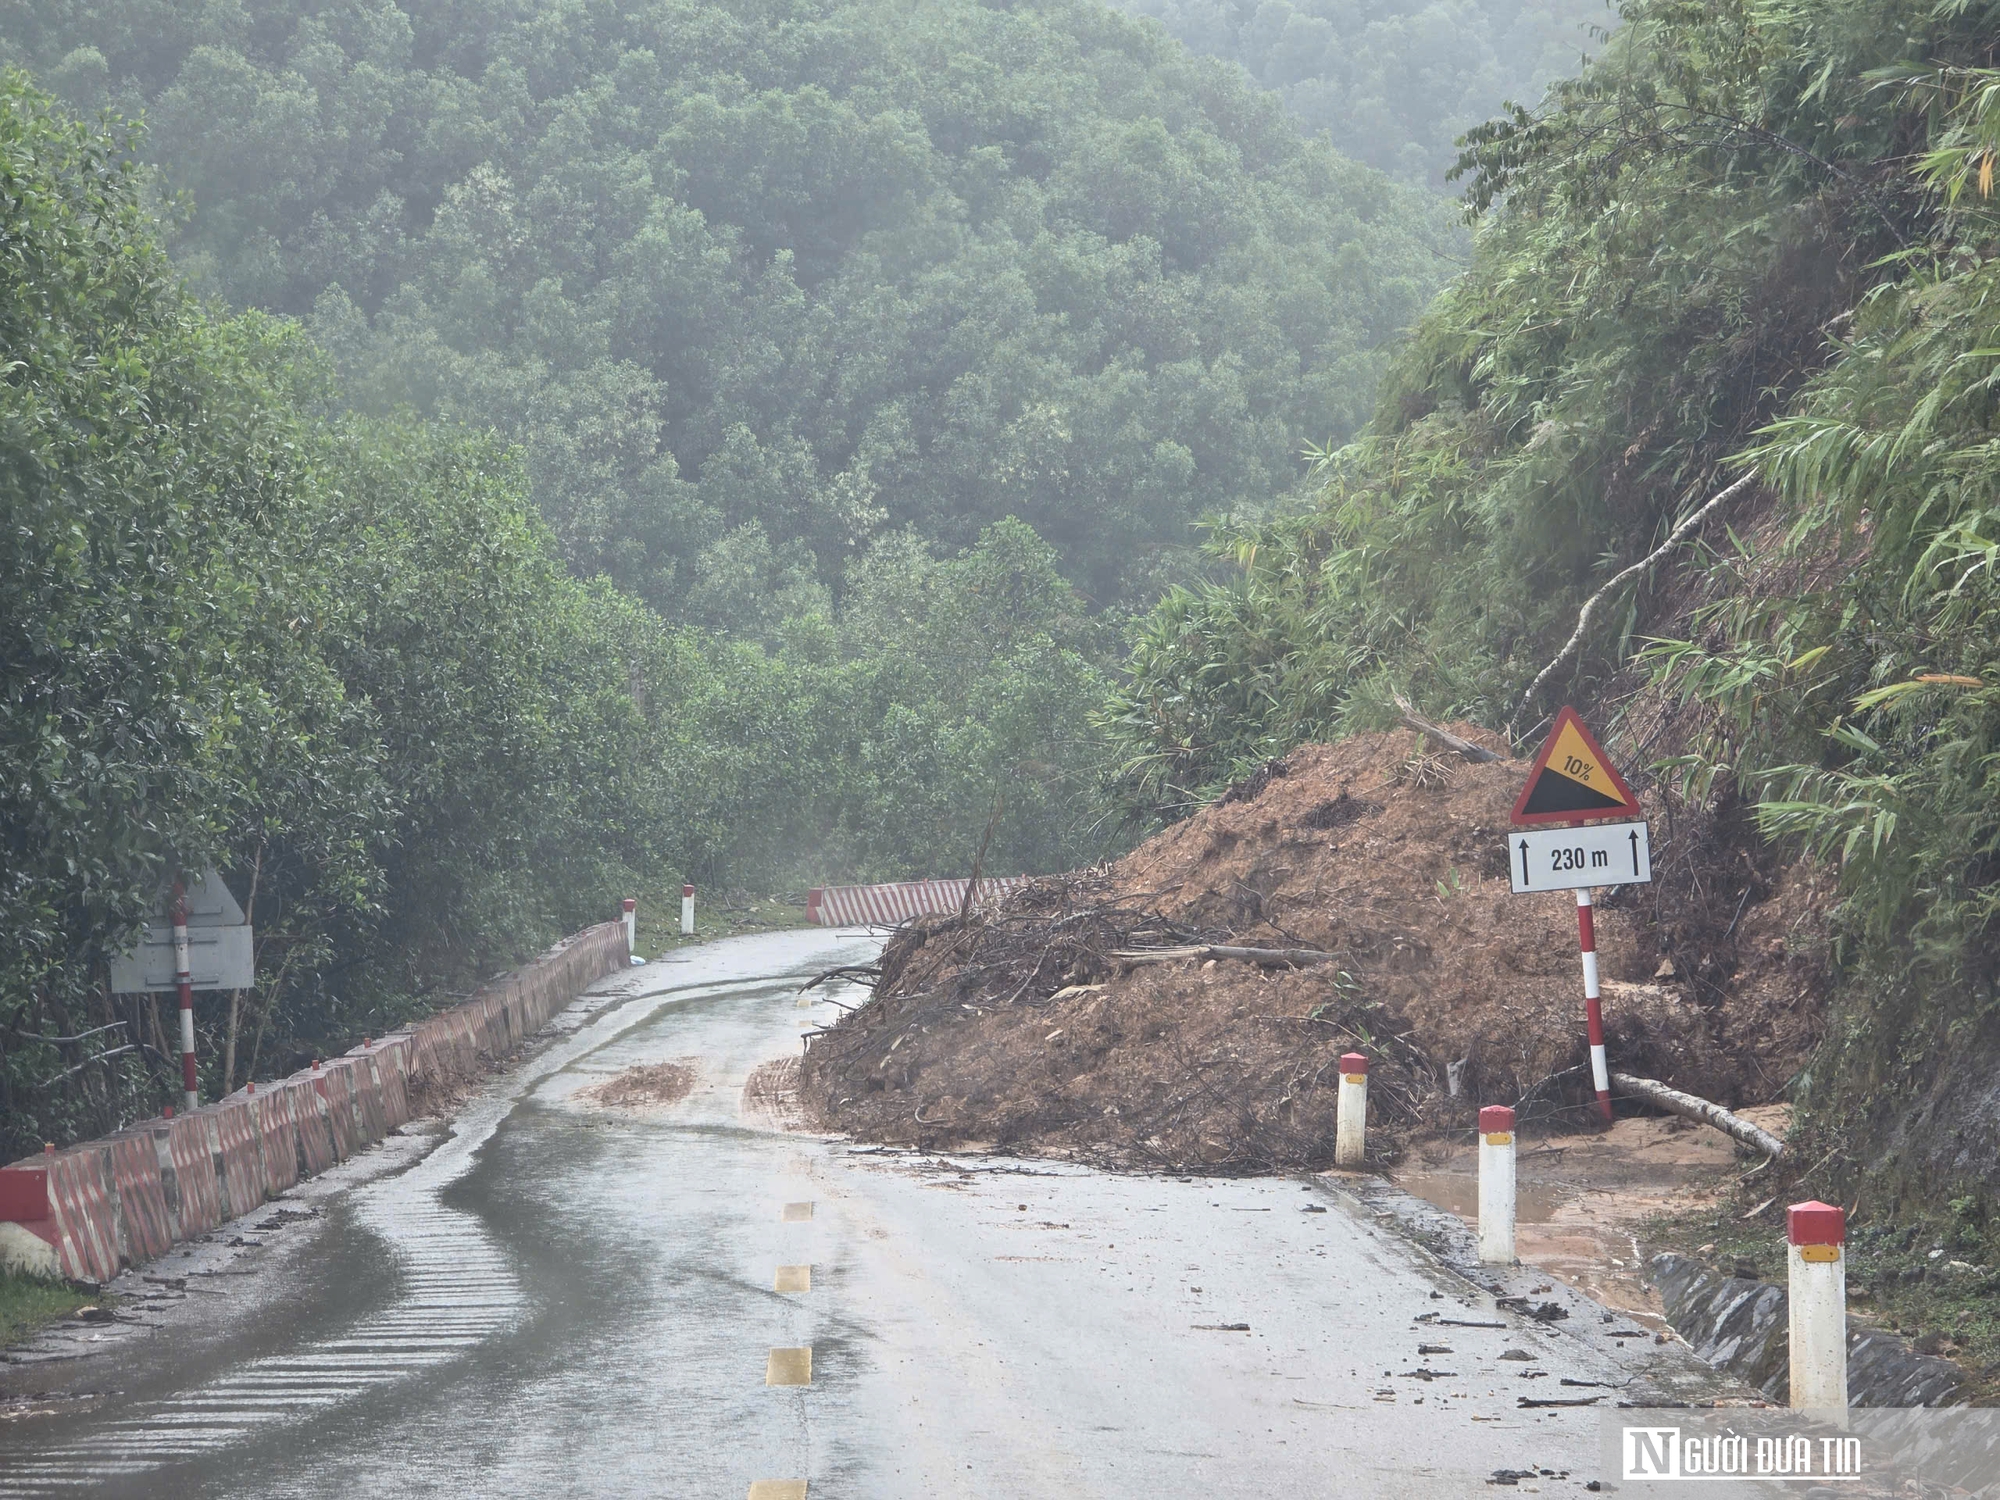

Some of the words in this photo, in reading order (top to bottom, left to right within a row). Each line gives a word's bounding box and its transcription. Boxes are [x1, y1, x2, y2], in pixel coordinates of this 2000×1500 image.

[1563, 755, 1594, 781] 10%
[1551, 847, 1585, 871] 230
[1591, 849, 1608, 868] m
